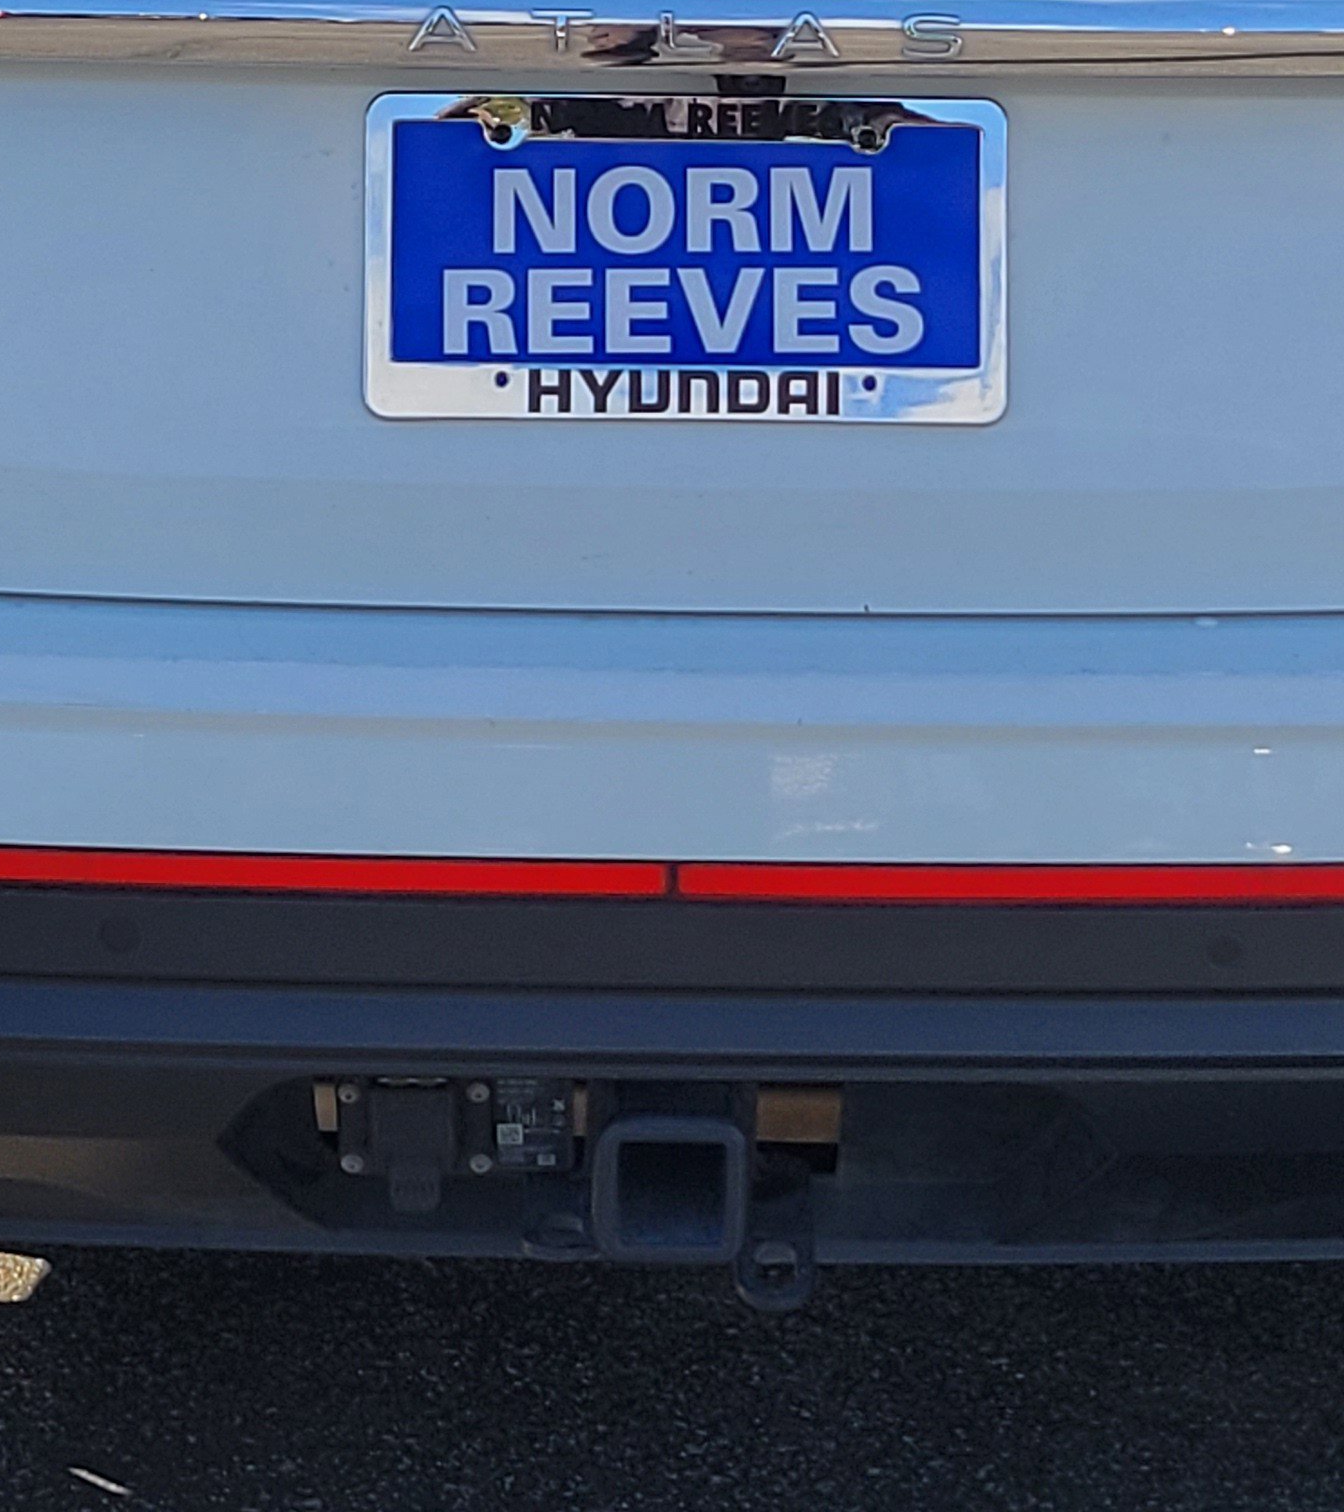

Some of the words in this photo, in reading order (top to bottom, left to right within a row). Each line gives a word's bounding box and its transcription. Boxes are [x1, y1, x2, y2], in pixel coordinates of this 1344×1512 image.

[408, 4, 964, 59] ATLAS
[492, 166, 873, 255] NORM
[442, 265, 924, 355] REEVES
[526, 369, 841, 416] HYUNDAI
